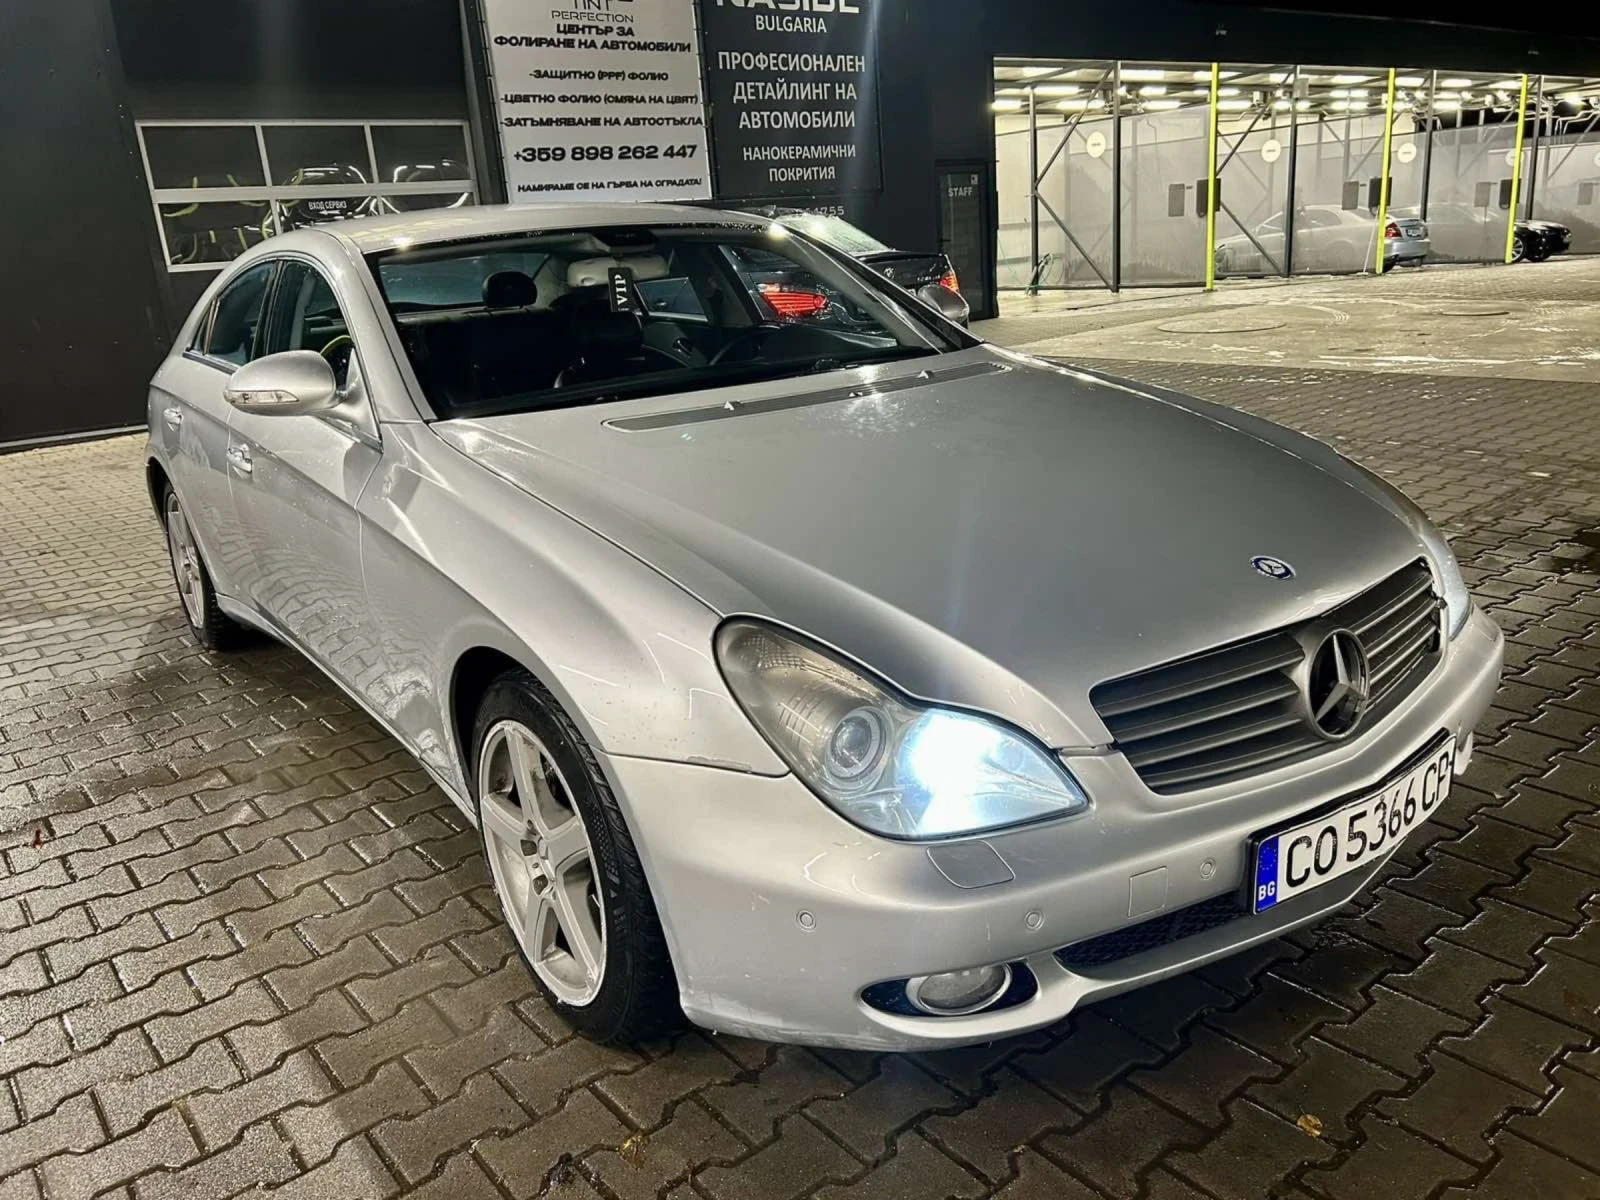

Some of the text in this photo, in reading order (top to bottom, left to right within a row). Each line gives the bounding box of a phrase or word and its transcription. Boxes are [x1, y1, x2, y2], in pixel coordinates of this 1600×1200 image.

[551, 10, 634, 23] PERFECTION
[755, 15, 827, 33] BULGARIA
[556, 23, 635, 37] ЦЕНТЪР ЗА
[494, 36, 691, 53] ФОЛИРАНЕ НА АВТОМОБИЛИ
[718, 51, 866, 73] ПРОФЕСИОНАЛЕН
[529, 69, 669, 81] -ЗАЩИТНО (PPF) ФОЛИО
[500, 93, 698, 105] -ЦВЕТНО ФОЛИО (СМЯНА НА ЦВЯТ)
[733, 77, 857, 104] ДЕТАЙЛИНГ НА
[500, 117, 703, 127] -ЗАТЪМНЯВАНЕ НА АВТОСТЪКЛА
[739, 110, 856, 129] АВТОМОБИЛИ
[514, 144, 698, 162] +359 898 262 447
[743, 144, 857, 161] НАНОКЕРАМИЧНИ
[769, 166, 836, 182] ПОКРИТИЯ
[517, 178, 702, 193] НАМИРАМЕ СЕ НА ГЪРБА НА ОГРАДАТА!
[948, 186, 973, 197] STAFF
[308, 200, 347, 211] ВХОД СЕРВИЗ
[614, 273, 628, 306] VIP
[1285, 824, 1338, 889] CO
[1345, 776, 1417, 864] 5366
[1258, 881, 1275, 901] BG
